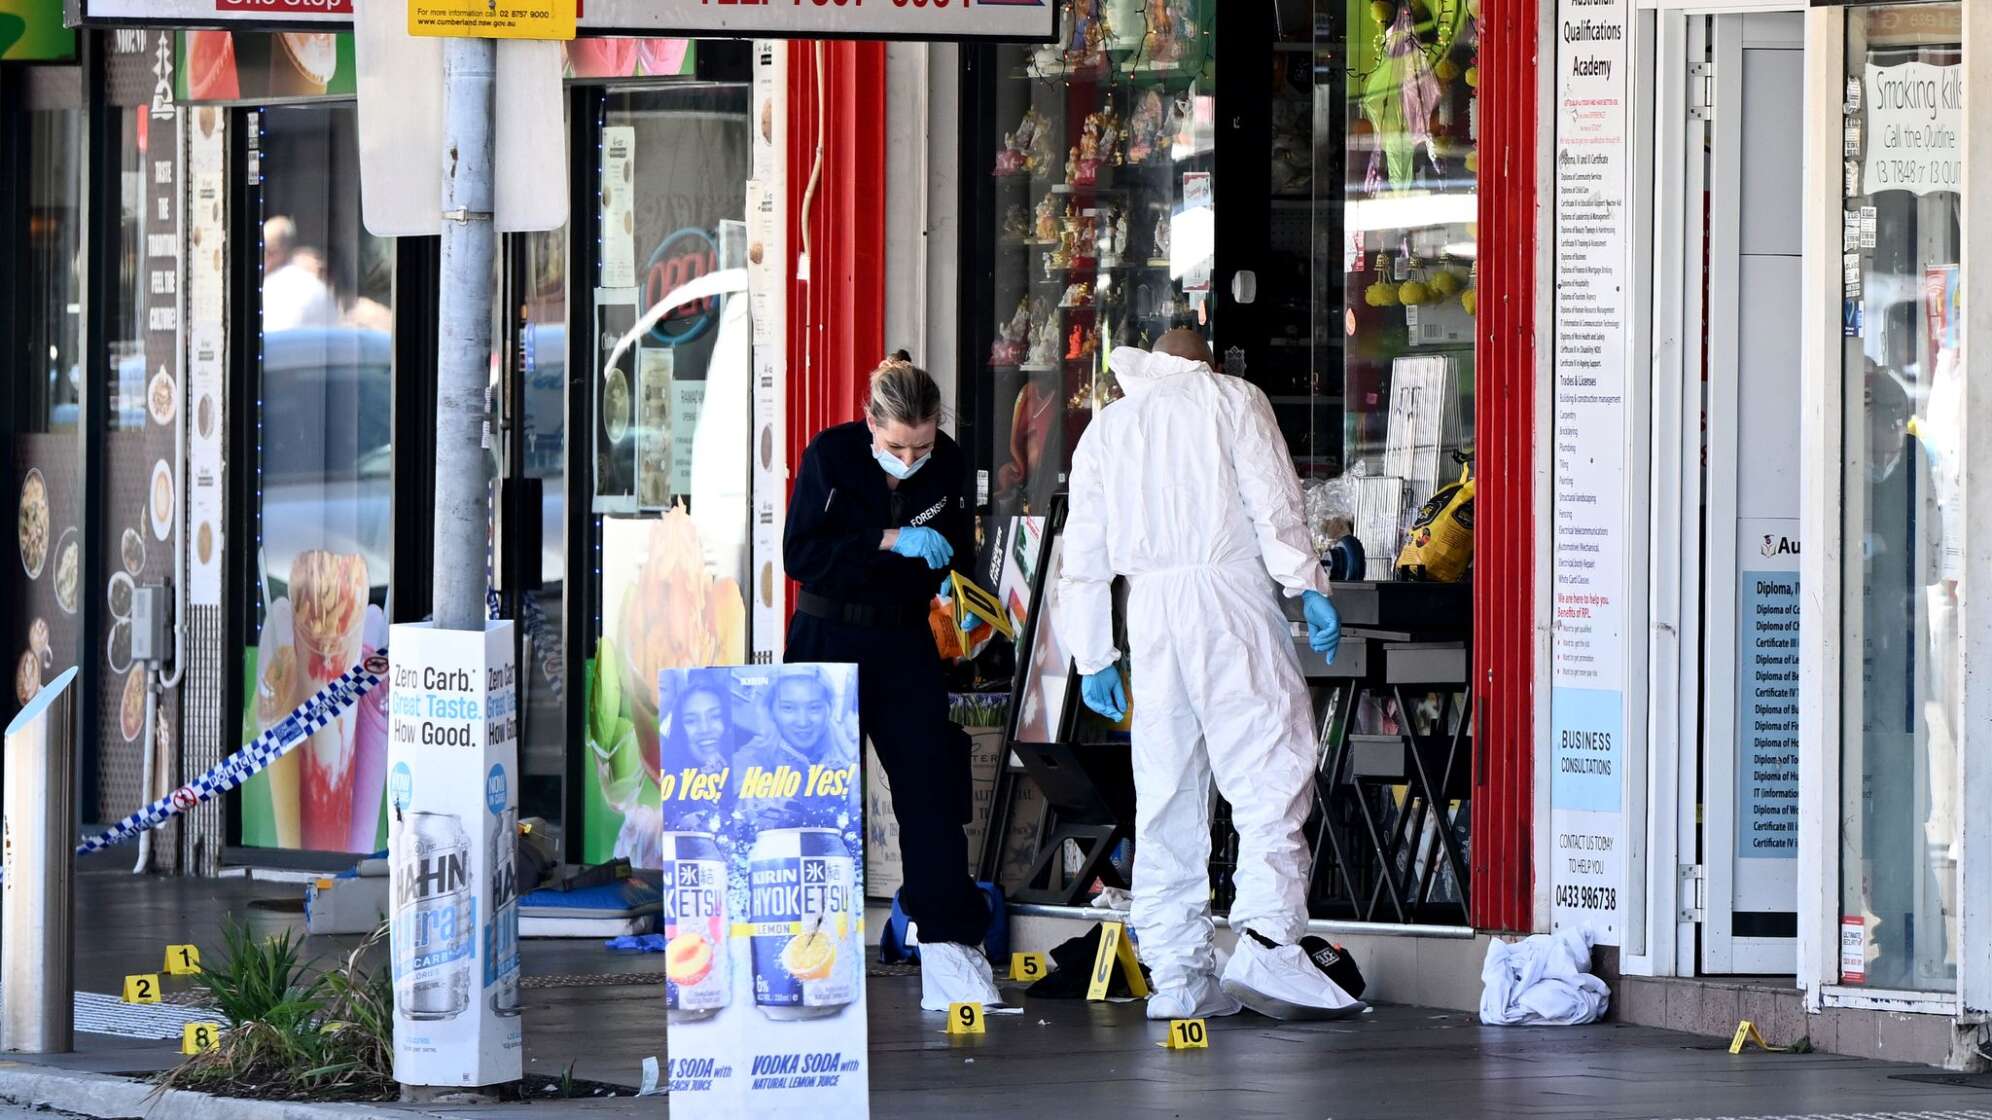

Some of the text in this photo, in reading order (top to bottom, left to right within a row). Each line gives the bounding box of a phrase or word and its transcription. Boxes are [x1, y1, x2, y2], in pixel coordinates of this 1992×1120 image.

[417, 8, 428, 16] For
[430, 9, 446, 17] more
[448, 9, 483, 18] information
[500, 10, 509, 18] 02
[1564, 19, 1621, 44] Qualifications
[1573, 54, 1611, 82] Academy
[1877, 70, 1937, 120] Smoking
[1884, 124, 1902, 149] Call
[1876, 160, 1888, 184] 13
[1891, 160, 1916, 184] 7848
[1930, 160, 1939, 184] 13
[1757, 581, 1794, 598] Diploma,
[1756, 603, 1784, 616] Diploma
[1784, 603, 1792, 615] of
[1756, 620, 1784, 633] Diploma
[1784, 620, 1792, 632] of
[1756, 637, 1789, 648] Certificate
[1756, 654, 1783, 667] Diploma
[1783, 654, 1791, 665] of
[394, 664, 418, 690] Zero
[1756, 671, 1782, 683] Diploma
[1783, 671, 1791, 681] of
[311, 682, 357, 718] POLICE
[1755, 687, 1788, 698] Certificate
[393, 691, 482, 720] Great Taste.
[1755, 704, 1782, 716] Diploma
[1783, 704, 1790, 714] of
[395, 719, 476, 748] How Good.
[488, 720, 506, 747] How
[1754, 720, 1790, 733] Diploma of
[1561, 730, 1612, 751] BUSINESS
[1754, 737, 1781, 749] Diploma
[1782, 737, 1790, 748] of
[209, 752, 256, 787] POLICE
[1561, 756, 1612, 776] CONSULTATIONS
[1754, 754, 1781, 767] Diploma
[1782, 754, 1790, 765] of
[679, 766, 730, 802] Yes!
[739, 763, 857, 800] Hello Yes!
[1753, 770, 1781, 783] Diploma
[1782, 771, 1789, 781] of
[1753, 787, 1760, 798] IT
[1753, 804, 1780, 816] Diploma
[1781, 804, 1789, 815] of
[1753, 821, 1786, 832] Certificate
[1559, 833, 1614, 852] CONTACT US TODAY
[1752, 837, 1786, 849] Certificate
[1568, 858, 1605, 875] TO HELP YOU
[396, 849, 468, 910] HAHN
[751, 867, 798, 887] KIRIN
[1555, 884, 1617, 911] 0433 986738
[757, 923, 791, 935] LEMON
[179, 948, 190, 967] 1
[1023, 956, 1038, 975] 5
[136, 979, 152, 999] 2
[958, 1005, 975, 1027] 9
[195, 1027, 209, 1048] 8
[1176, 1021, 1204, 1044] 10
[676, 1058, 715, 1078] SODA
[714, 1065, 733, 1078] with
[751, 1052, 860, 1076] VODKA SODA with
[690, 1079, 713, 1091] JUICE
[752, 1074, 841, 1090] NATURAL LEMON JUICE
